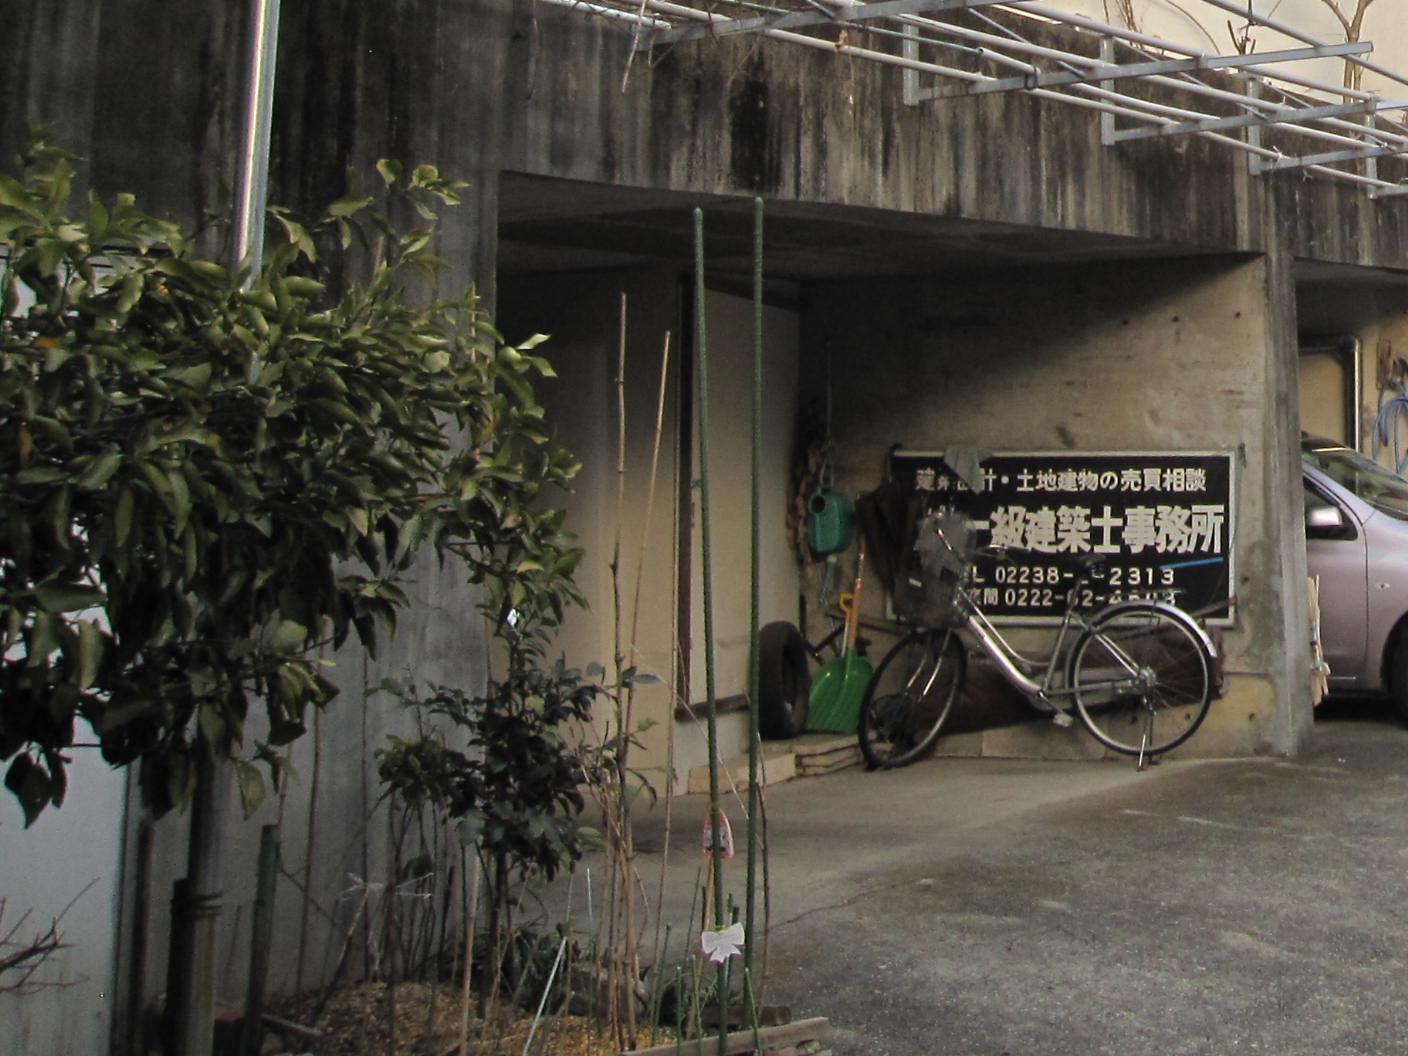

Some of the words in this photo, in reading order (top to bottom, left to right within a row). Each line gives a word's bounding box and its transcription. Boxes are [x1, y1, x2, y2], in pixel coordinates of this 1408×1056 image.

[915, 467, 1207, 492] 建計・土地建物の売買相談
[995, 566, 1175, 585] 02238--2313
